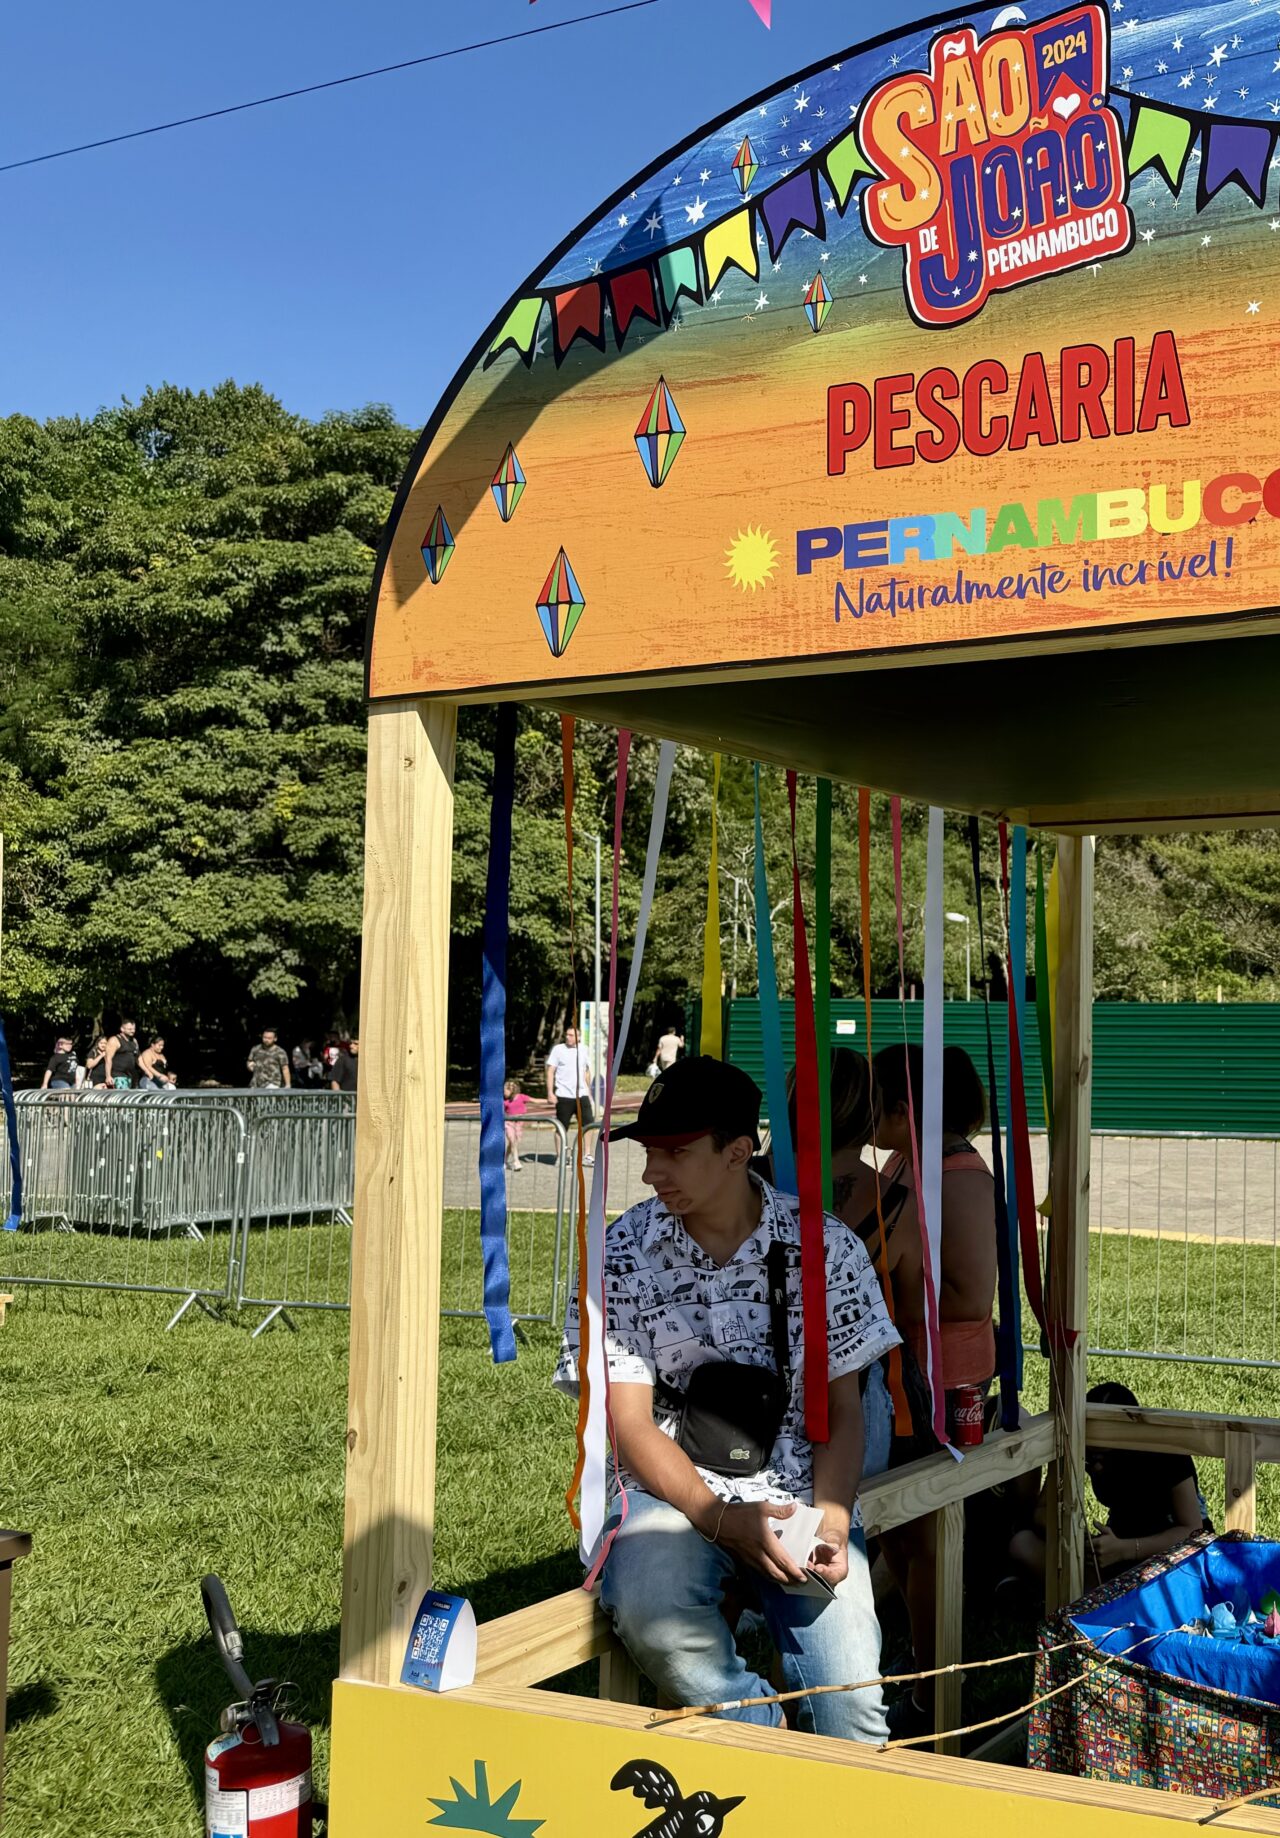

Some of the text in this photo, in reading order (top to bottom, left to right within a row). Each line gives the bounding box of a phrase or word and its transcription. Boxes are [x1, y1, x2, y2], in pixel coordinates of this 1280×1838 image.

[1041, 29, 1087, 69] 2024
[871, 36, 1031, 231] SÃO
[918, 228, 939, 254] DE
[919, 113, 1114, 310] JOÃO
[987, 207, 1119, 277] PERNAMBUCO
[826, 330, 1190, 477] PESCARIA
[834, 536, 1234, 622] Naturalmente incrível!
